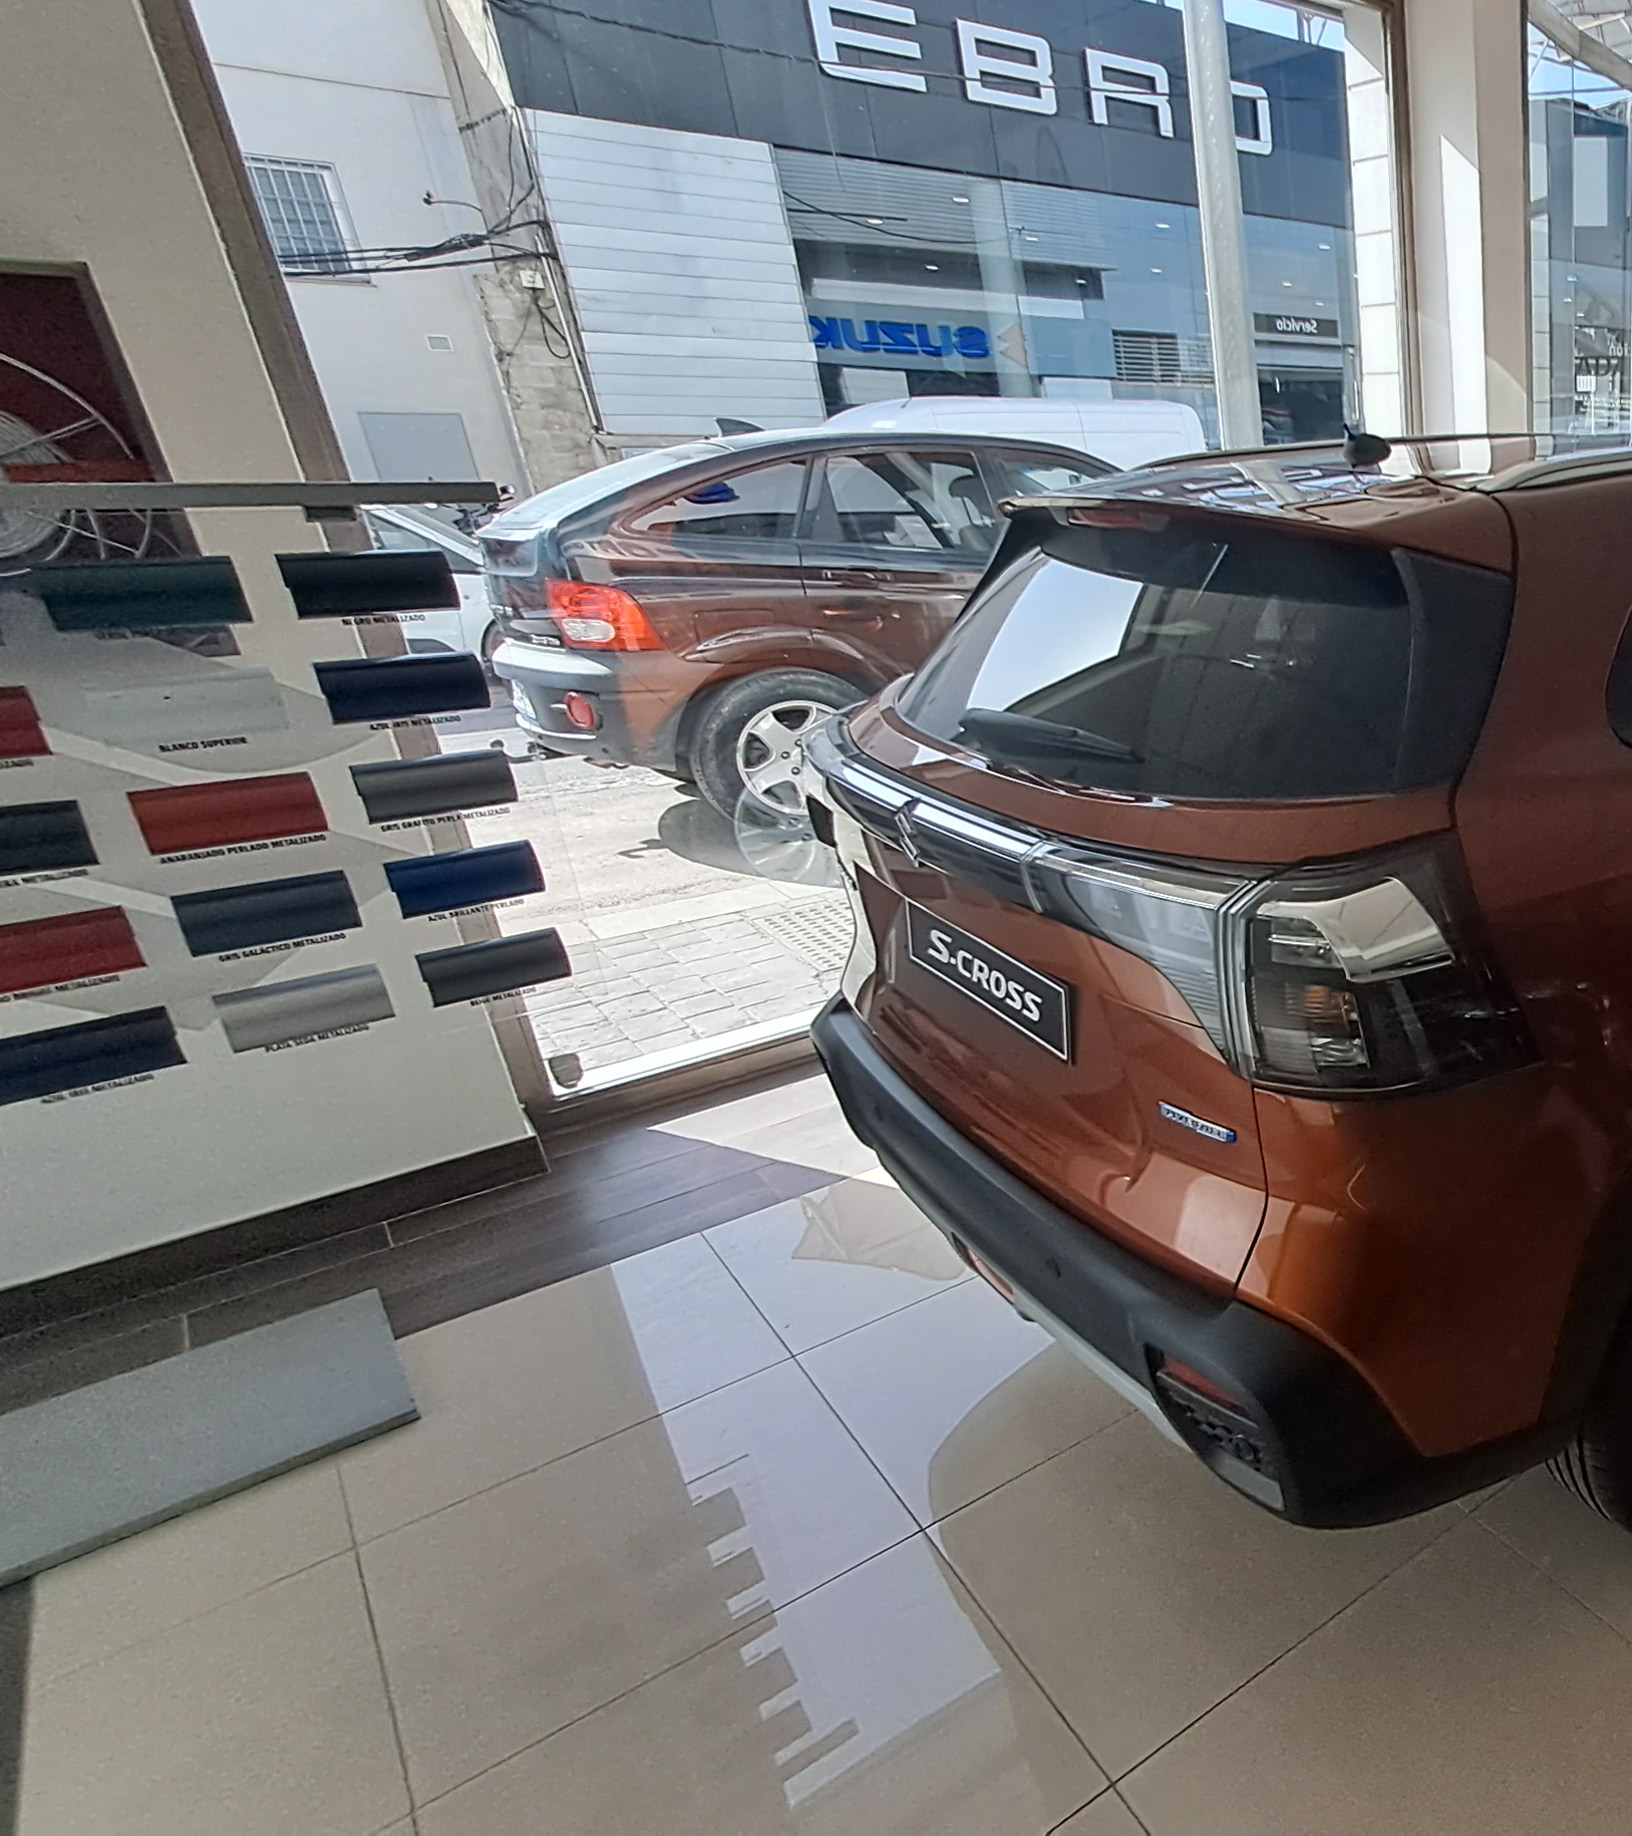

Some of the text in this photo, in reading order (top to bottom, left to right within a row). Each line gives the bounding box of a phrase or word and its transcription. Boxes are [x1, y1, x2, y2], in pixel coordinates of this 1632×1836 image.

[342, 613, 426, 626] NEGRO METALIZADO
[369, 722, 391, 731] AZUL
[411, 714, 461, 726] METALIZADO
[158, 736, 248, 753] BLANCO SUPERIOR
[380, 806, 511, 833] GRIS GRAFITO PERLA METALIZADO
[159, 833, 327, 865] ANARANJADO PERLADO METALIZADO
[427, 898, 525, 922] AZUL BRILLANTE PERLADO
[218, 953, 241, 963] GRIS
[292, 932, 347, 949] METALIZADO
[927, 929, 1043, 1022] S.CROSS
[492, 986, 537, 1001] METALIZADO
[264, 1042, 292, 1053] PLATA
[317, 1023, 370, 1042] METALIZADO
